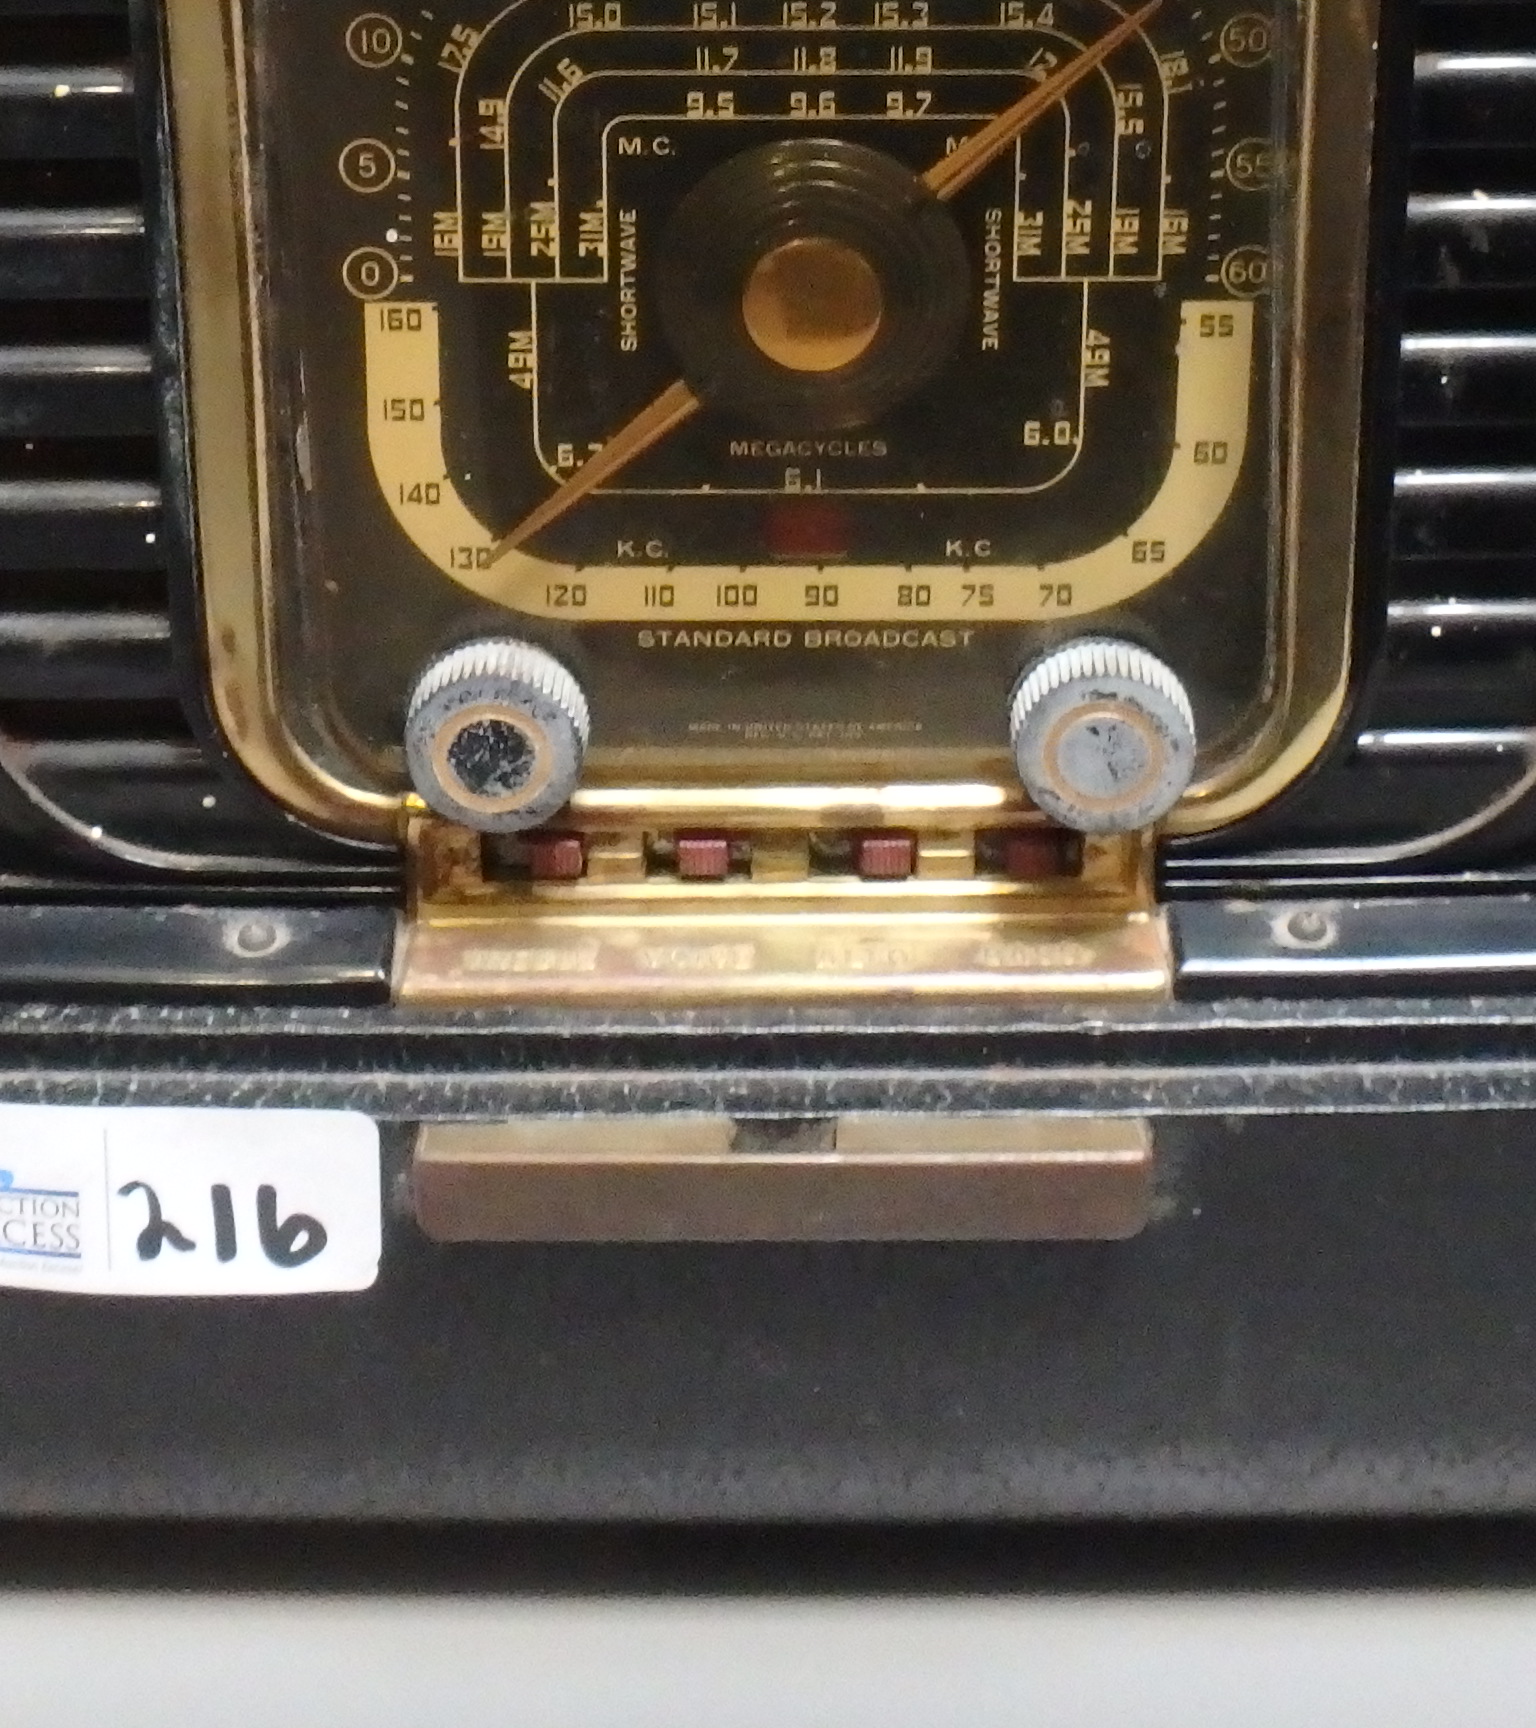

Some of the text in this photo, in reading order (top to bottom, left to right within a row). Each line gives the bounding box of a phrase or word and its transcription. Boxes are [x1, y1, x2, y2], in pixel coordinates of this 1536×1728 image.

[568, 1, 622, 29] 15.0
[693, 1, 738, 29] 15.1
[781, 1, 838, 29] 15.2
[874, 1, 930, 29] 15.3
[999, 1, 1054, 29] 15.4
[361, 27, 392, 54] 10
[1228, 27, 1267, 54] 50
[695, 46, 740, 72] 11.7
[793, 46, 838, 72] 11.8
[890, 46, 934, 72] 11.9
[686, 90, 734, 119] 9.5
[789, 90, 837, 119] 9.6
[886, 90, 933, 119] 9.7
[478, 97, 506, 150] 14.9
[617, 136, 676, 156] M.C.
[357, 153, 377, 179] 5
[432, 211, 460, 258] 16M
[481, 211, 509, 258] 19M
[529, 201, 557, 258] 25M
[579, 211, 608, 258] 31M
[1016, 210, 1044, 257] 31M
[1064, 199, 1093, 255] 25M
[1113, 208, 1141, 255] 19M
[360, 260, 380, 287] 0
[619, 208, 639, 353] SHORTWAVE
[981, 207, 1003, 351] SHORTWAVE
[1227, 258, 1268, 285] 60
[380, 308, 422, 333] 160
[1199, 313, 1234, 338] 55
[507, 330, 535, 390] 49M
[1084, 329, 1112, 388] 49M
[383, 398, 425, 423] 150
[730, 440, 888, 458] MEGACYCLES
[1193, 440, 1229, 465] 60
[398, 482, 442, 507] 140
[449, 546, 494, 571] 130
[616, 539, 670, 559] K.C.
[1131, 539, 1166, 564] 65
[545, 583, 588, 608] 120
[644, 583, 675, 608] 110
[716, 583, 758, 608] 100
[804, 583, 839, 608] 90
[897, 583, 931, 608] 80
[961, 583, 995, 608] 75
[1038, 583, 1073, 608] 70
[637, 628, 976, 649] STANDARD BROADCAST
[118, 1180, 328, 1268] 216
